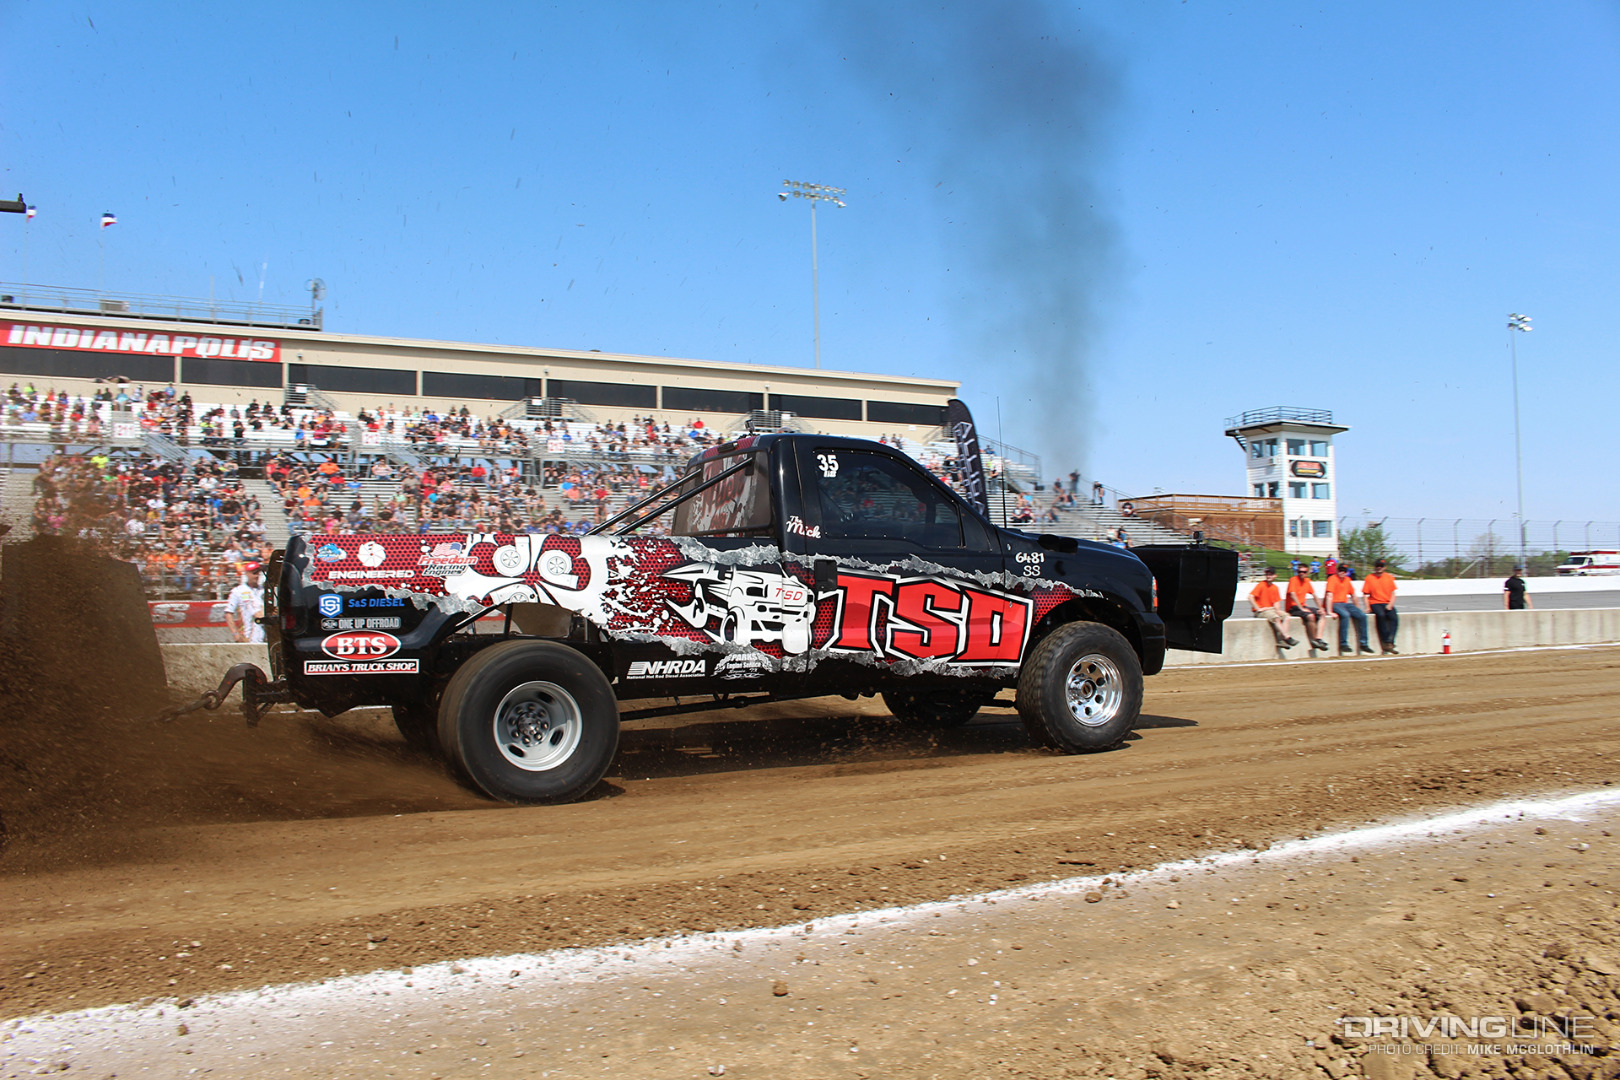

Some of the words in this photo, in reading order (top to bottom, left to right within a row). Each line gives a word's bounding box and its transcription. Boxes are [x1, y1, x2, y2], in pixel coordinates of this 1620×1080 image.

[8, 324, 276, 360] INDIANAPOLIS
[816, 454, 839, 471] 35
[786, 521, 821, 538] Mick
[419, 555, 478, 565] Freedom
[1015, 551, 1045, 564] 6481
[328, 570, 415, 579] ENGINEERED
[775, 587, 803, 601] TSD
[348, 598, 368, 608] S&S
[369, 598, 405, 607] DIESEL
[338, 619, 354, 629] ONE
[354, 619, 366, 628] UP
[366, 618, 400, 628] OFFROAD
[834, 570, 1028, 664] TSD
[336, 636, 388, 655] BTS
[308, 664, 350, 672] BRIAN'S
[351, 663, 385, 671] TRUCK
[640, 659, 706, 674] NHRDA
